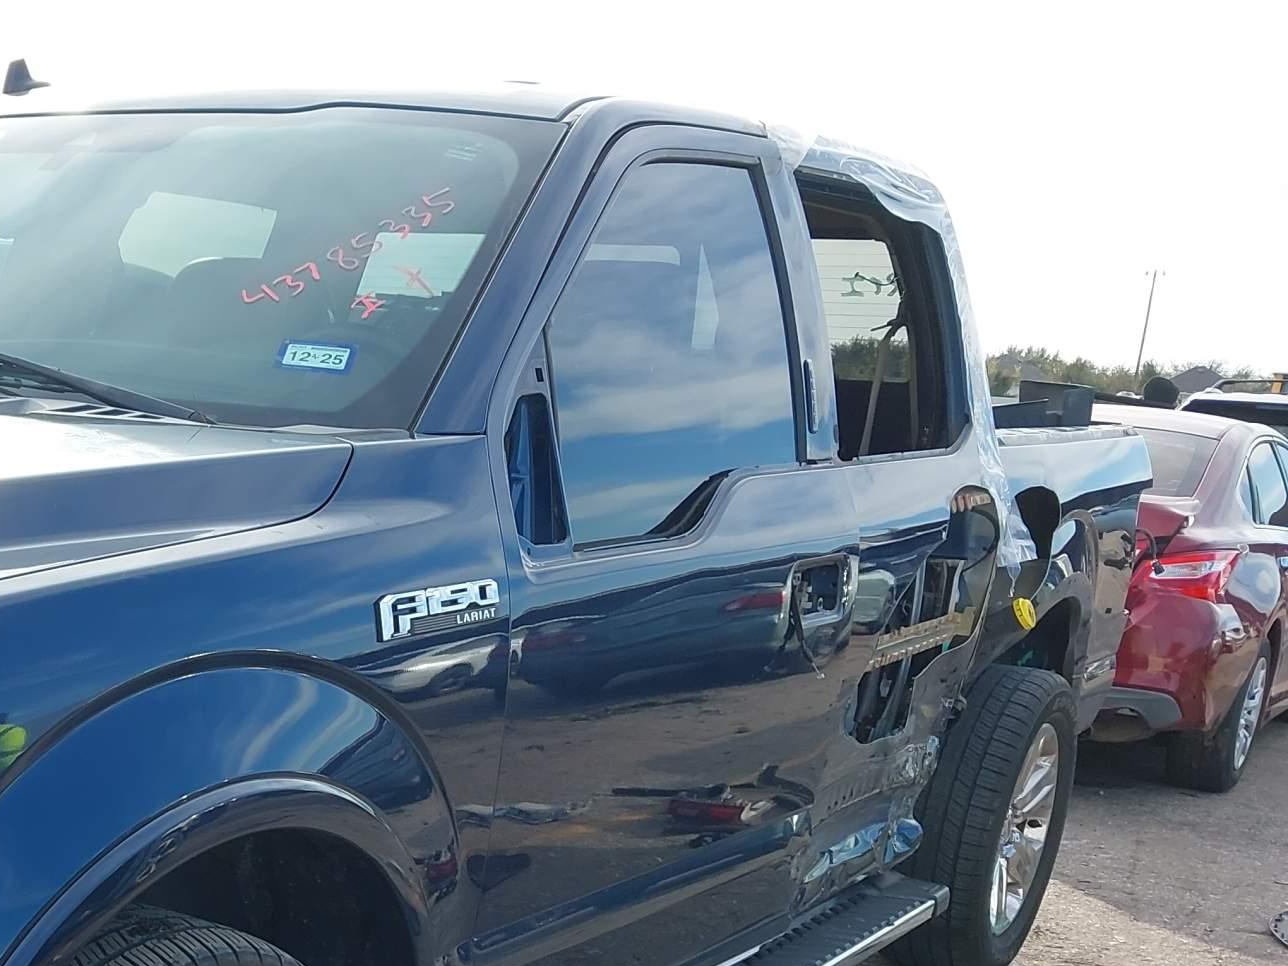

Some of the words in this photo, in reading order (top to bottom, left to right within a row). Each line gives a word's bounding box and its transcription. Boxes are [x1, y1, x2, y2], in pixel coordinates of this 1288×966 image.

[290, 350, 311, 362] 12
[320, 353, 344, 365] 25
[456, 608, 496, 624] LARIAT
